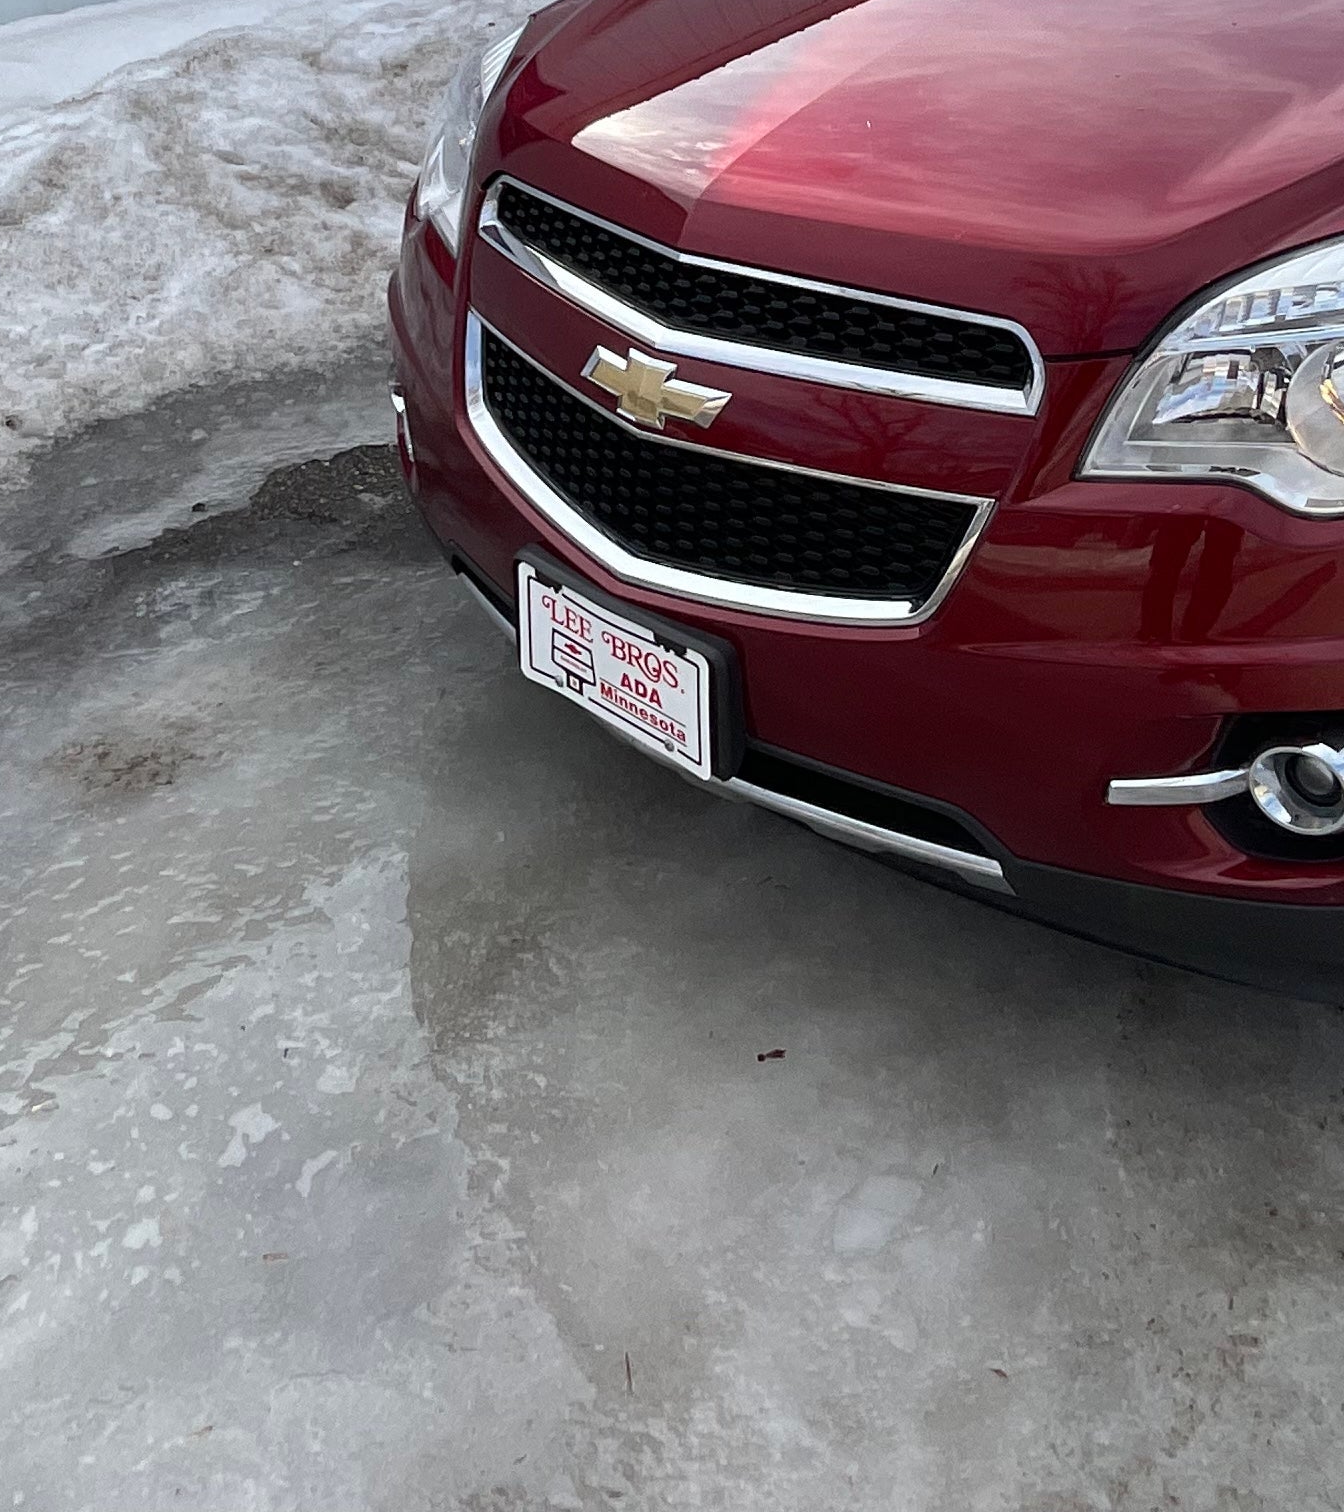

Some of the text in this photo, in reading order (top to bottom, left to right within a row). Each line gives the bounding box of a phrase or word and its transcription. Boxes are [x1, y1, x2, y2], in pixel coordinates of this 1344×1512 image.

[541, 594, 594, 643] LEE
[600, 682, 687, 743] Minnesota
[620, 672, 663, 709] ADA
